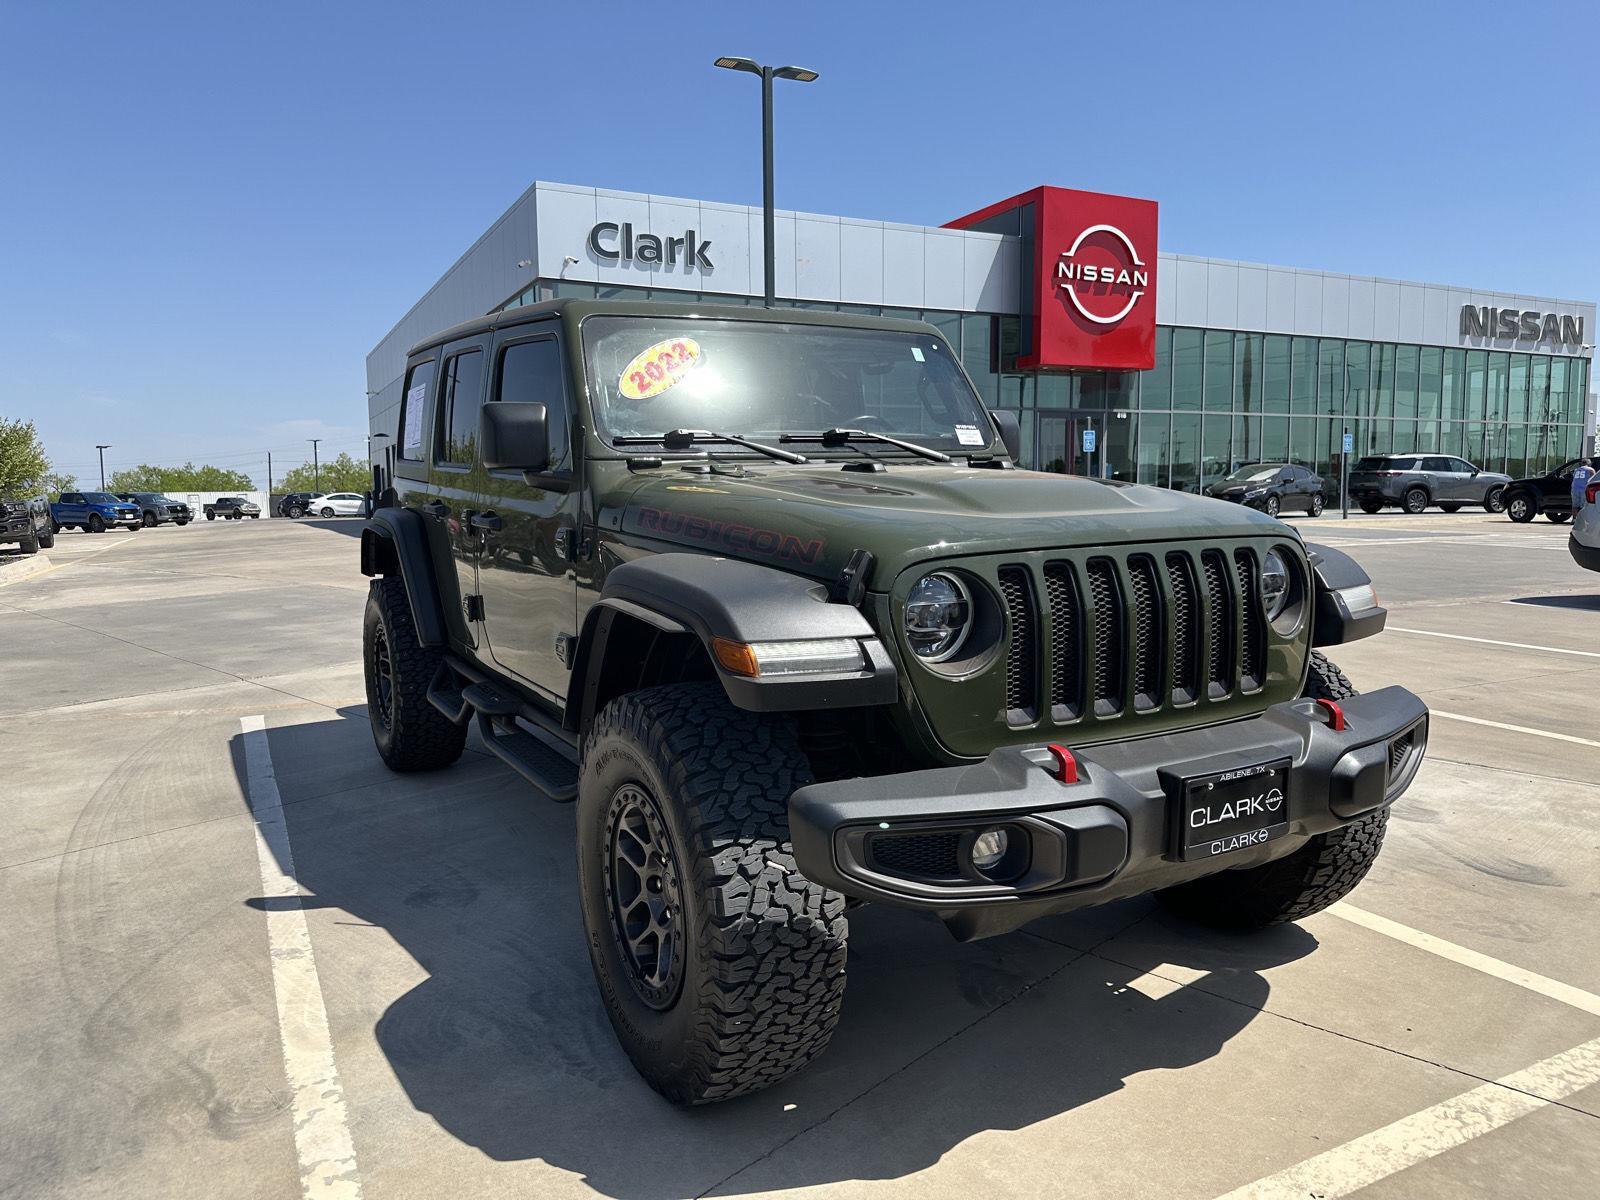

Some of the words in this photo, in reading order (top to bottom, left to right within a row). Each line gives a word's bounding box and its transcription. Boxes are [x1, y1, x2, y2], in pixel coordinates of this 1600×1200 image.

[586, 221, 714, 270] Clark
[1058, 261, 1148, 287] NISSAN
[1460, 304, 1584, 345] NISSAN
[636, 506, 826, 565] RUBICON
[1256, 765, 1266, 774] TX
[1191, 794, 1264, 828] CLARK
[1211, 831, 1259, 855] CLARK
